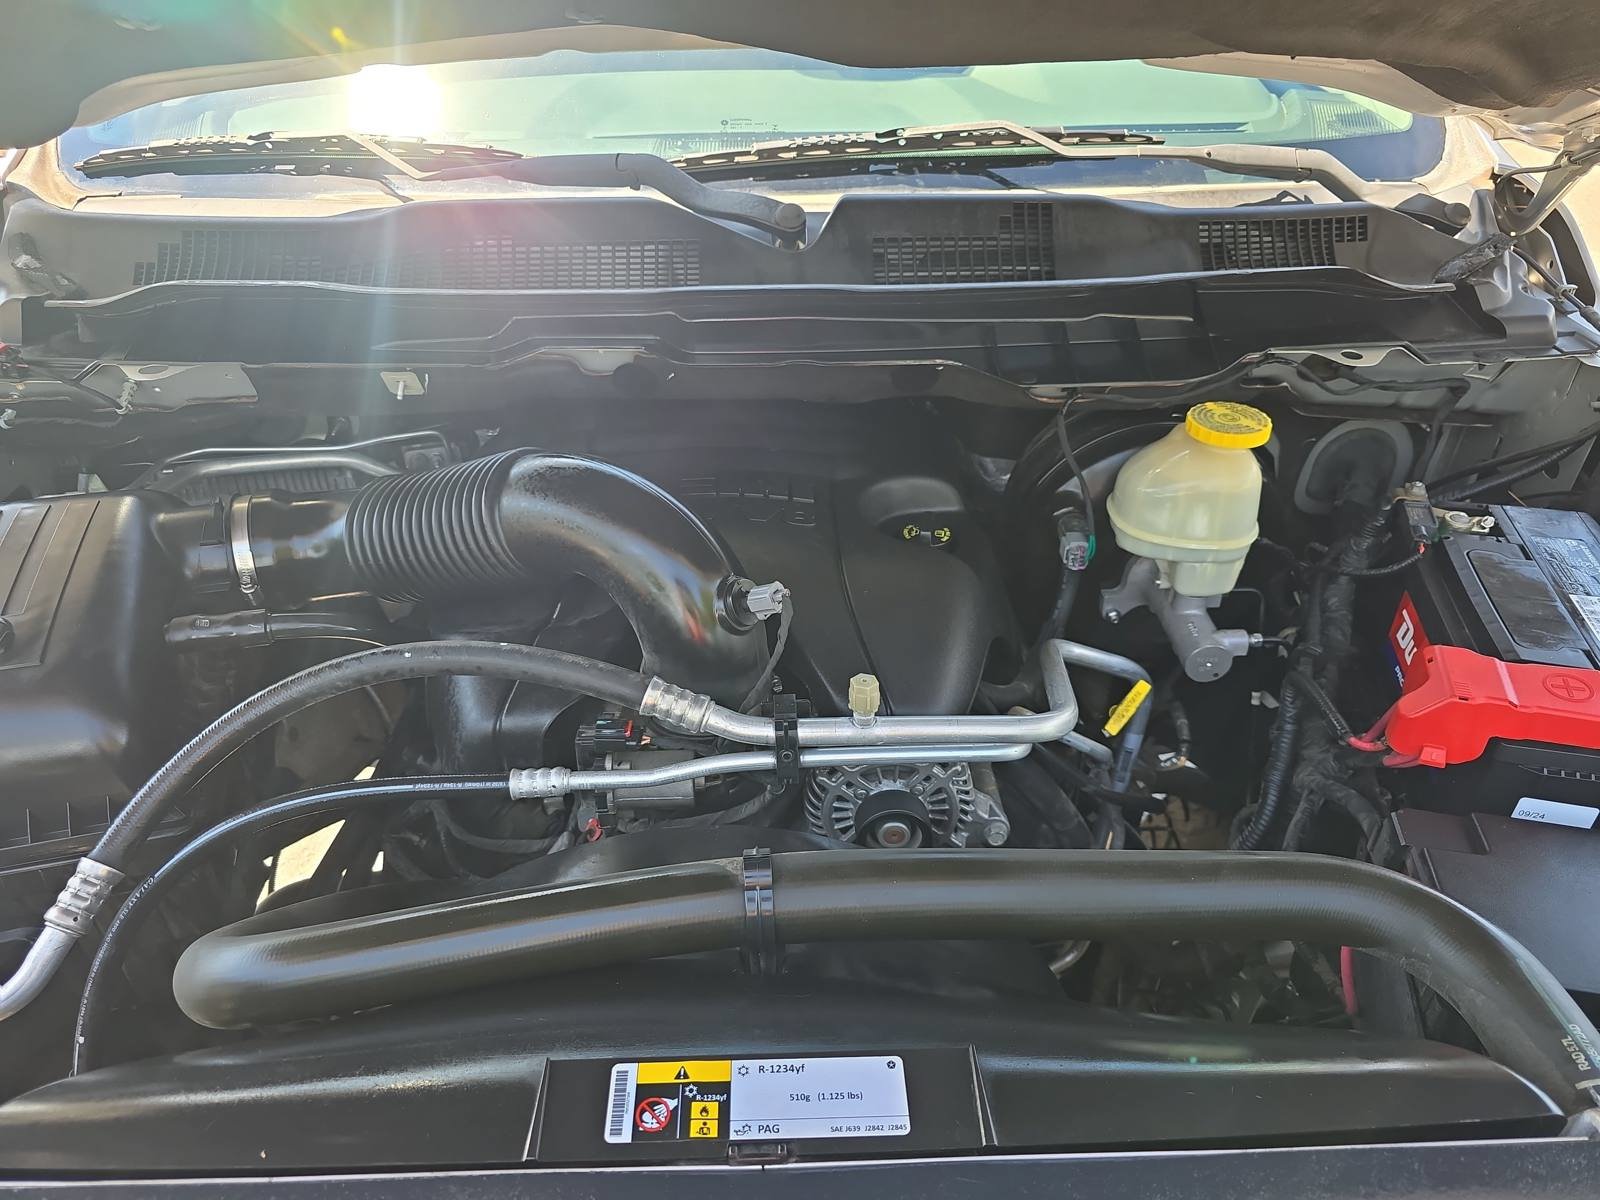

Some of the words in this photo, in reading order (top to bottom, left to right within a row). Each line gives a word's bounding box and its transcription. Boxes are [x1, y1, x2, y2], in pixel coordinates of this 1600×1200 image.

[1518, 809, 1546, 820] 09/24
[1571, 1051, 1591, 1071] RAD
[758, 1063, 806, 1075] R-1234yf
[696, 1093, 728, 1102] R-1234yf
[789, 1093, 811, 1103] 510g
[817, 1092, 845, 1102] (1.125
[847, 1091, 864, 1101] lbs)
[757, 1124, 781, 1134] PAG
[830, 1125, 844, 1133] SAE
[845, 1125, 861, 1133] J639
[864, 1124, 885, 1132] J2842
[887, 1123, 908, 1131] J2845
